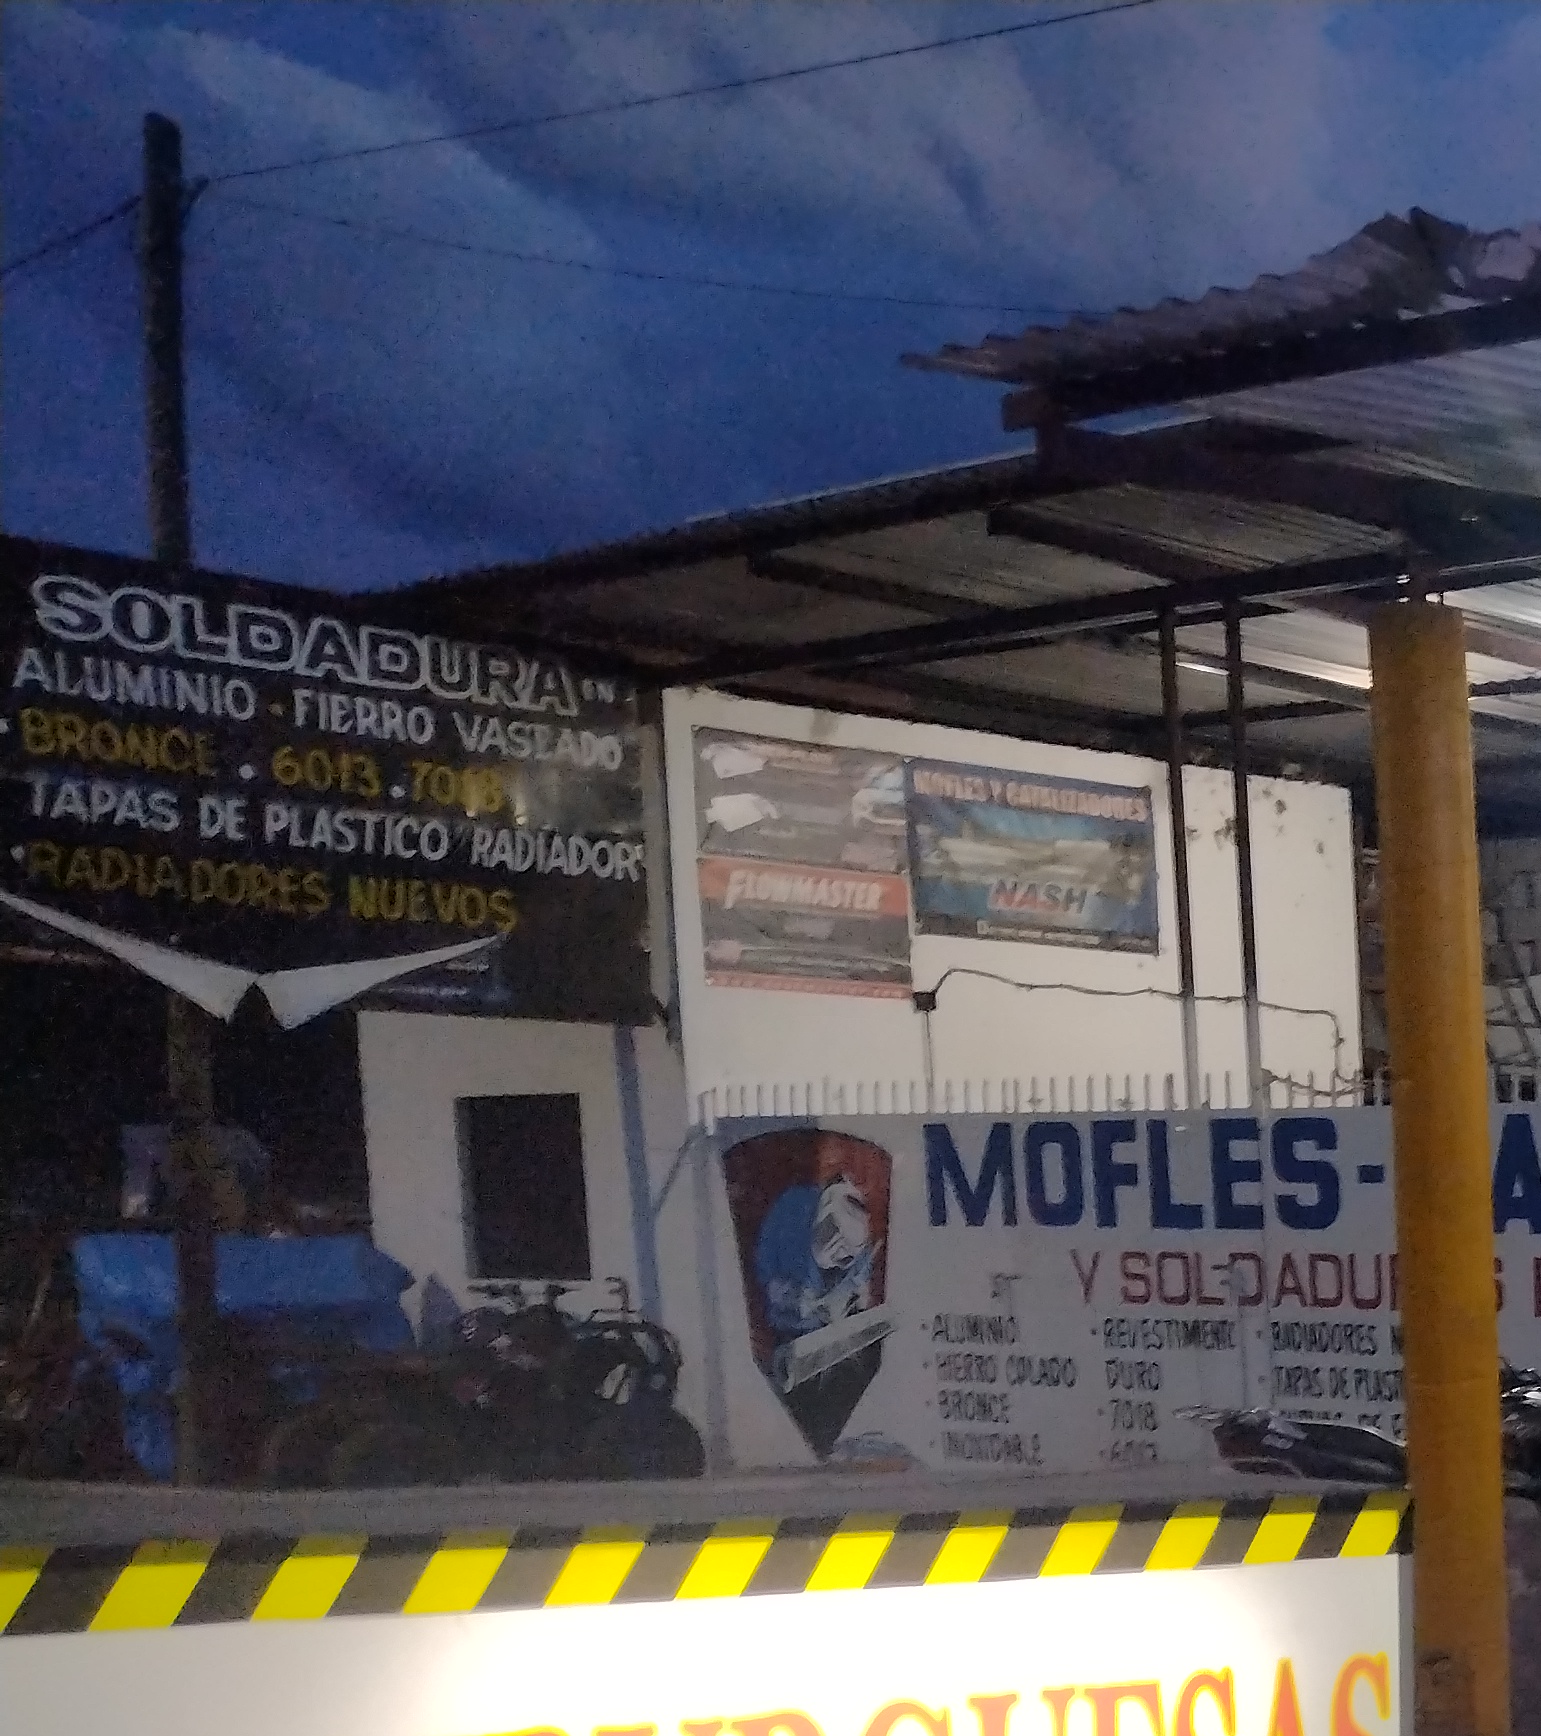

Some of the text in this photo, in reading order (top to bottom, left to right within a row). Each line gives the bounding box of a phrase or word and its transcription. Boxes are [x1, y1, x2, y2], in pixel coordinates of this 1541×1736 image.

[32, 574, 579, 717] SOLDADURA
[12, 648, 256, 721] ALUMINIO
[293, 687, 436, 746] FIERRO
[19, 706, 217, 778] BRONCE
[271, 746, 382, 798] 6013
[26, 770, 182, 832] TAPAS
[199, 796, 248, 842] DE
[263, 802, 450, 862] PLASTICO
[28, 840, 520, 935] RADIADORES NUEVOS
[992, 879, 1088, 914] NASH
[1069, 1249, 1098, 1298] Y
[1105, 1357, 1164, 1392] DURO
